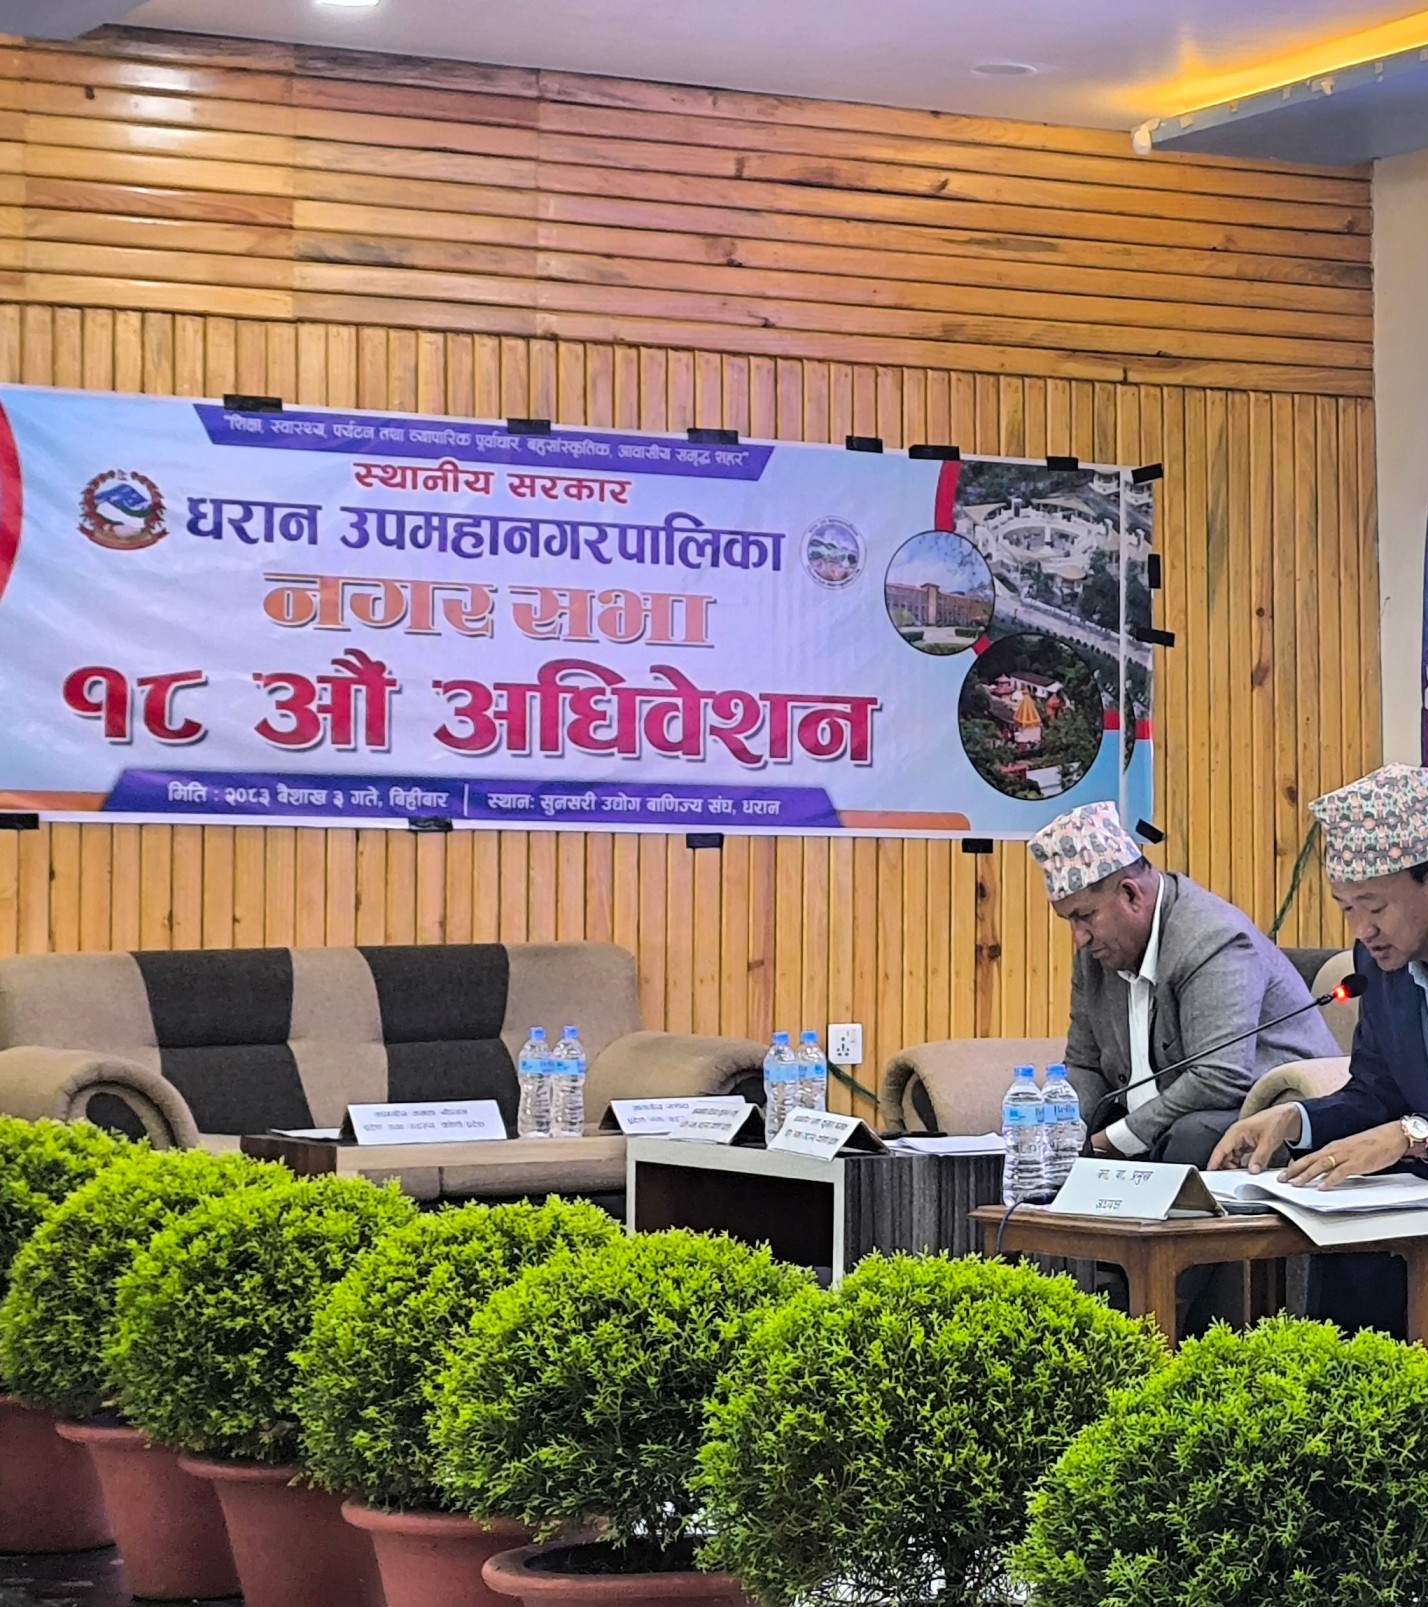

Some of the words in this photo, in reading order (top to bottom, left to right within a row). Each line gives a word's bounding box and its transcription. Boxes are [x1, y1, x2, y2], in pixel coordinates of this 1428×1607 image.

[380, 428, 405, 442] तथा
[354, 457, 495, 495] स्थानीय
[507, 472, 632, 504] सरकार
[186, 496, 322, 546] धरान
[339, 505, 786, 573] उपमहानगरपालिका
[262, 571, 497, 637] नगर
[509, 584, 717, 648] सभा
[61, 665, 209, 746] १८
[431, 657, 882, 771] अधिवेशन
[167, 780, 207, 803] मिति
[224, 786, 270, 809] २०८३
[333, 789, 344, 809] ३
[350, 786, 383, 809] गते,
[539, 791, 597, 816] सुनसरी
[601, 791, 642, 813] उद्योग
[742, 800, 781, 815] धरान
